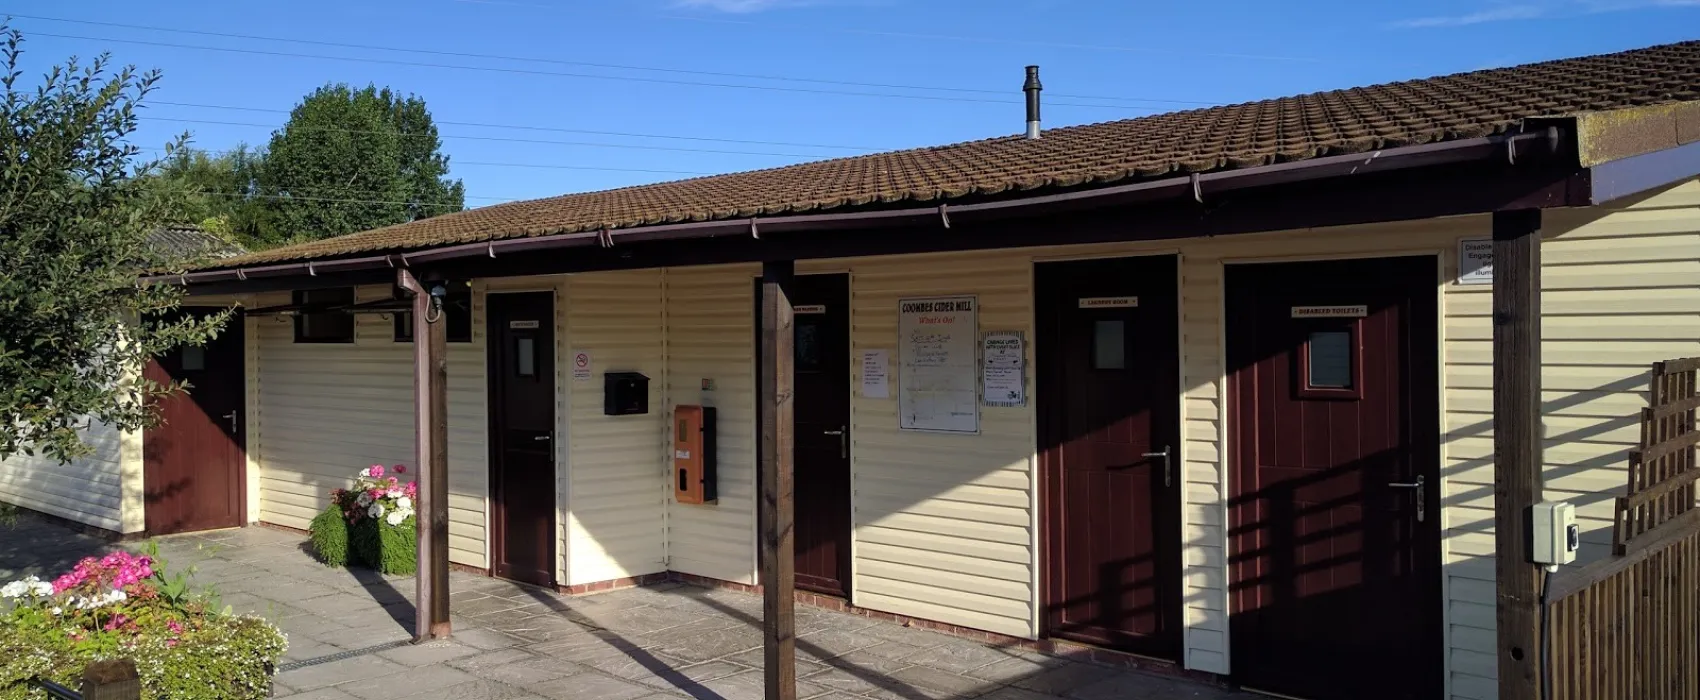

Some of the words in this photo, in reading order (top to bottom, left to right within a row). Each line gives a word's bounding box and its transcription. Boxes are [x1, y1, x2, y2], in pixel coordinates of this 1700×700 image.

[902, 302, 934, 313] COOMBES
[934, 302, 955, 312] CIDER
[955, 301, 972, 311] MILL
[919, 316, 941, 324] What's
[942, 316, 956, 324] On!
